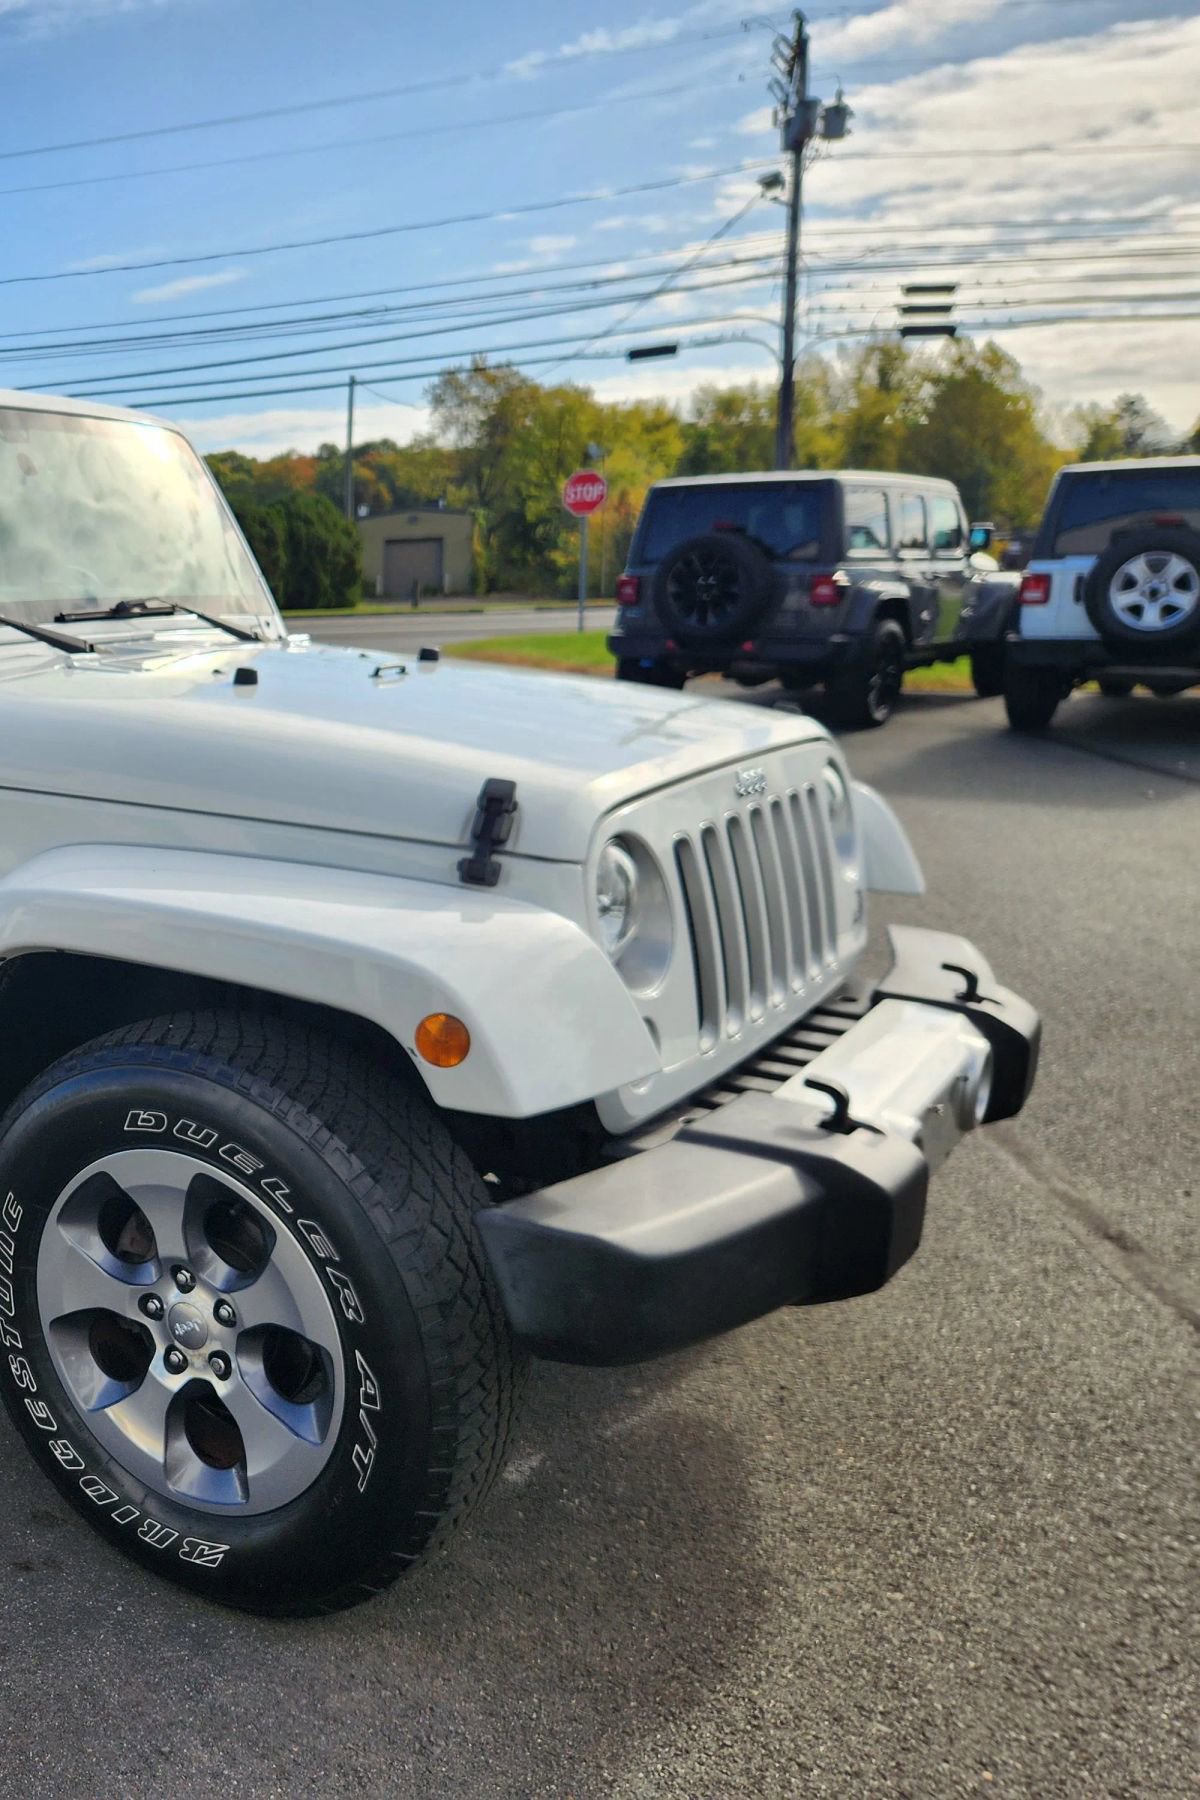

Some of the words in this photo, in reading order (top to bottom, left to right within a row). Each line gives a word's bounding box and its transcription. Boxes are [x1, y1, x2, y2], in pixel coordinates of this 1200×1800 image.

[566, 482, 605, 504] STOP
[123, 1109, 366, 1325] DUELER
[351, 1348, 383, 1495] A/T
